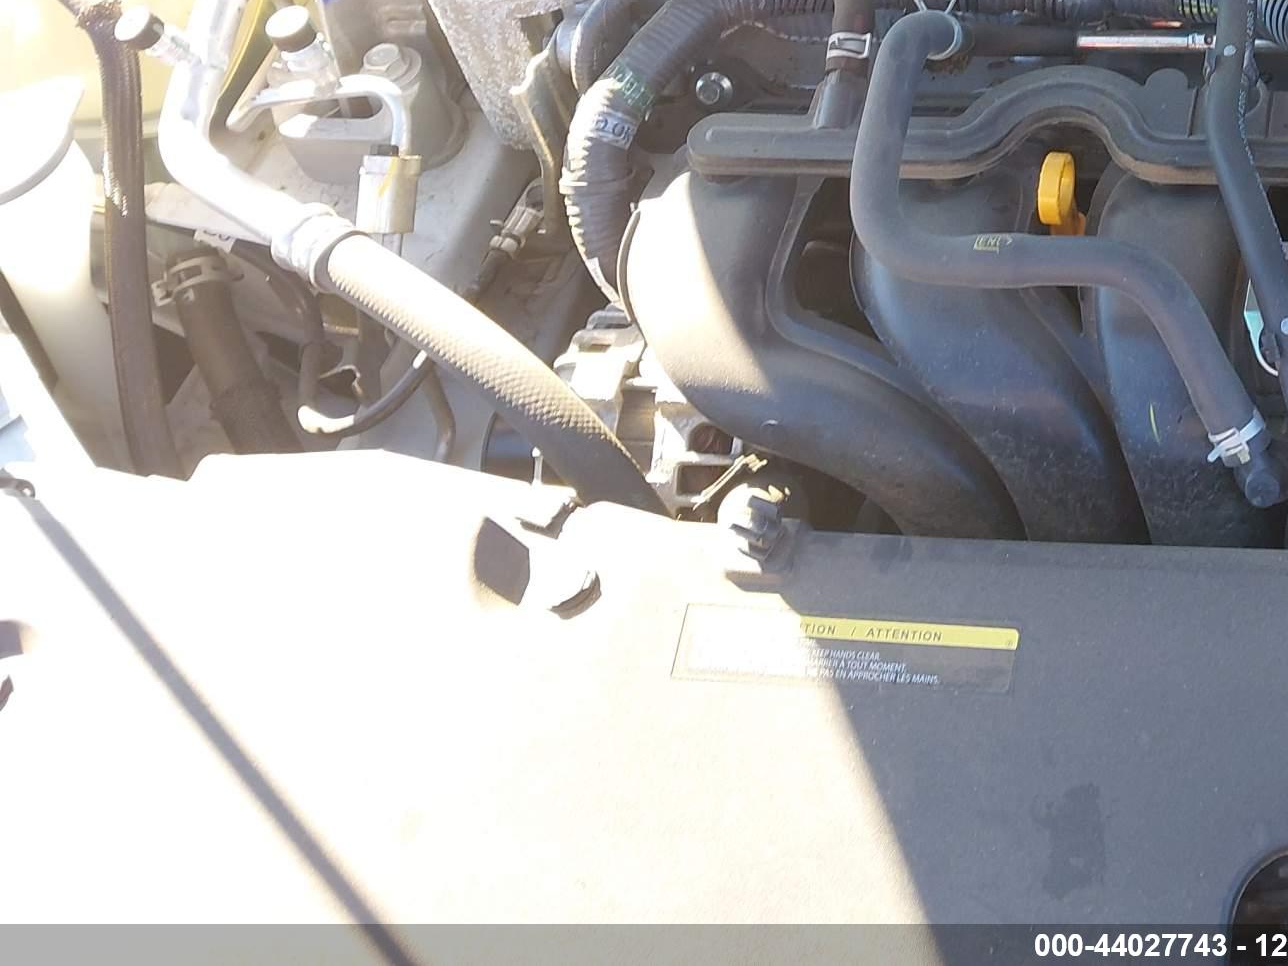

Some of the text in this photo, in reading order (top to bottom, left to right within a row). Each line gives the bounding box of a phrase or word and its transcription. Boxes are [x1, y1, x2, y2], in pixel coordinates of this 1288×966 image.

[865, 627, 943, 642] ATTENTION
[830, 650, 856, 659] HANDS
[847, 661, 868, 669] TOUT
[834, 669, 846, 679] EN
[847, 671, 897, 682] APPROCHER
[897, 673, 911, 683] LES
[911, 673, 940, 684] MAINS.
